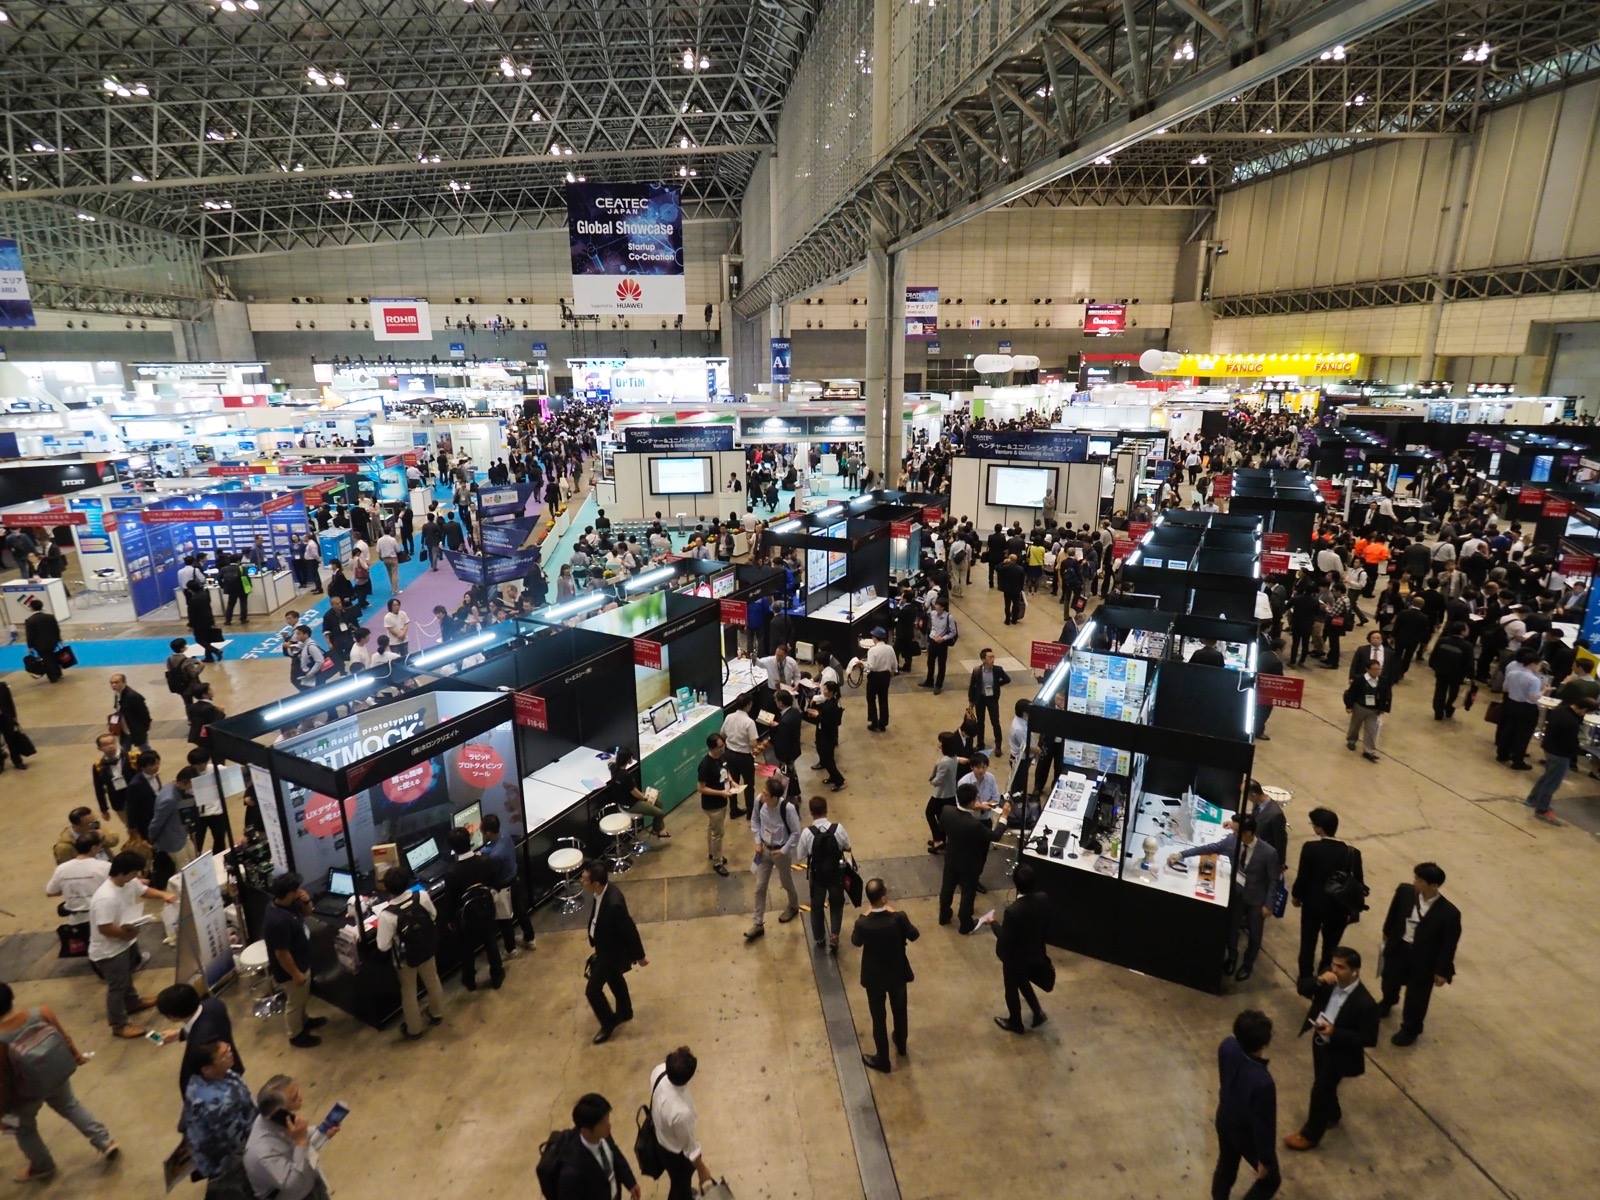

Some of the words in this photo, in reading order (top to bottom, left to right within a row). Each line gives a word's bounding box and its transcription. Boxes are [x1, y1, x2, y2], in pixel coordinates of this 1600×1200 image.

[595, 197, 649, 209] CEATEC
[576, 220, 613, 235] Global
[616, 221, 674, 235] Showcase
[628, 242, 656, 251] Startup
[628, 253, 675, 261] Co-Creation
[386, 315, 417, 323] ROHM
[773, 356, 790, 368] AI
[1315, 362, 1352, 372] FANUC
[1226, 364, 1263, 373] FANUC
[331, 730, 359, 747] Rapid
[362, 712, 420, 736] prototyping
